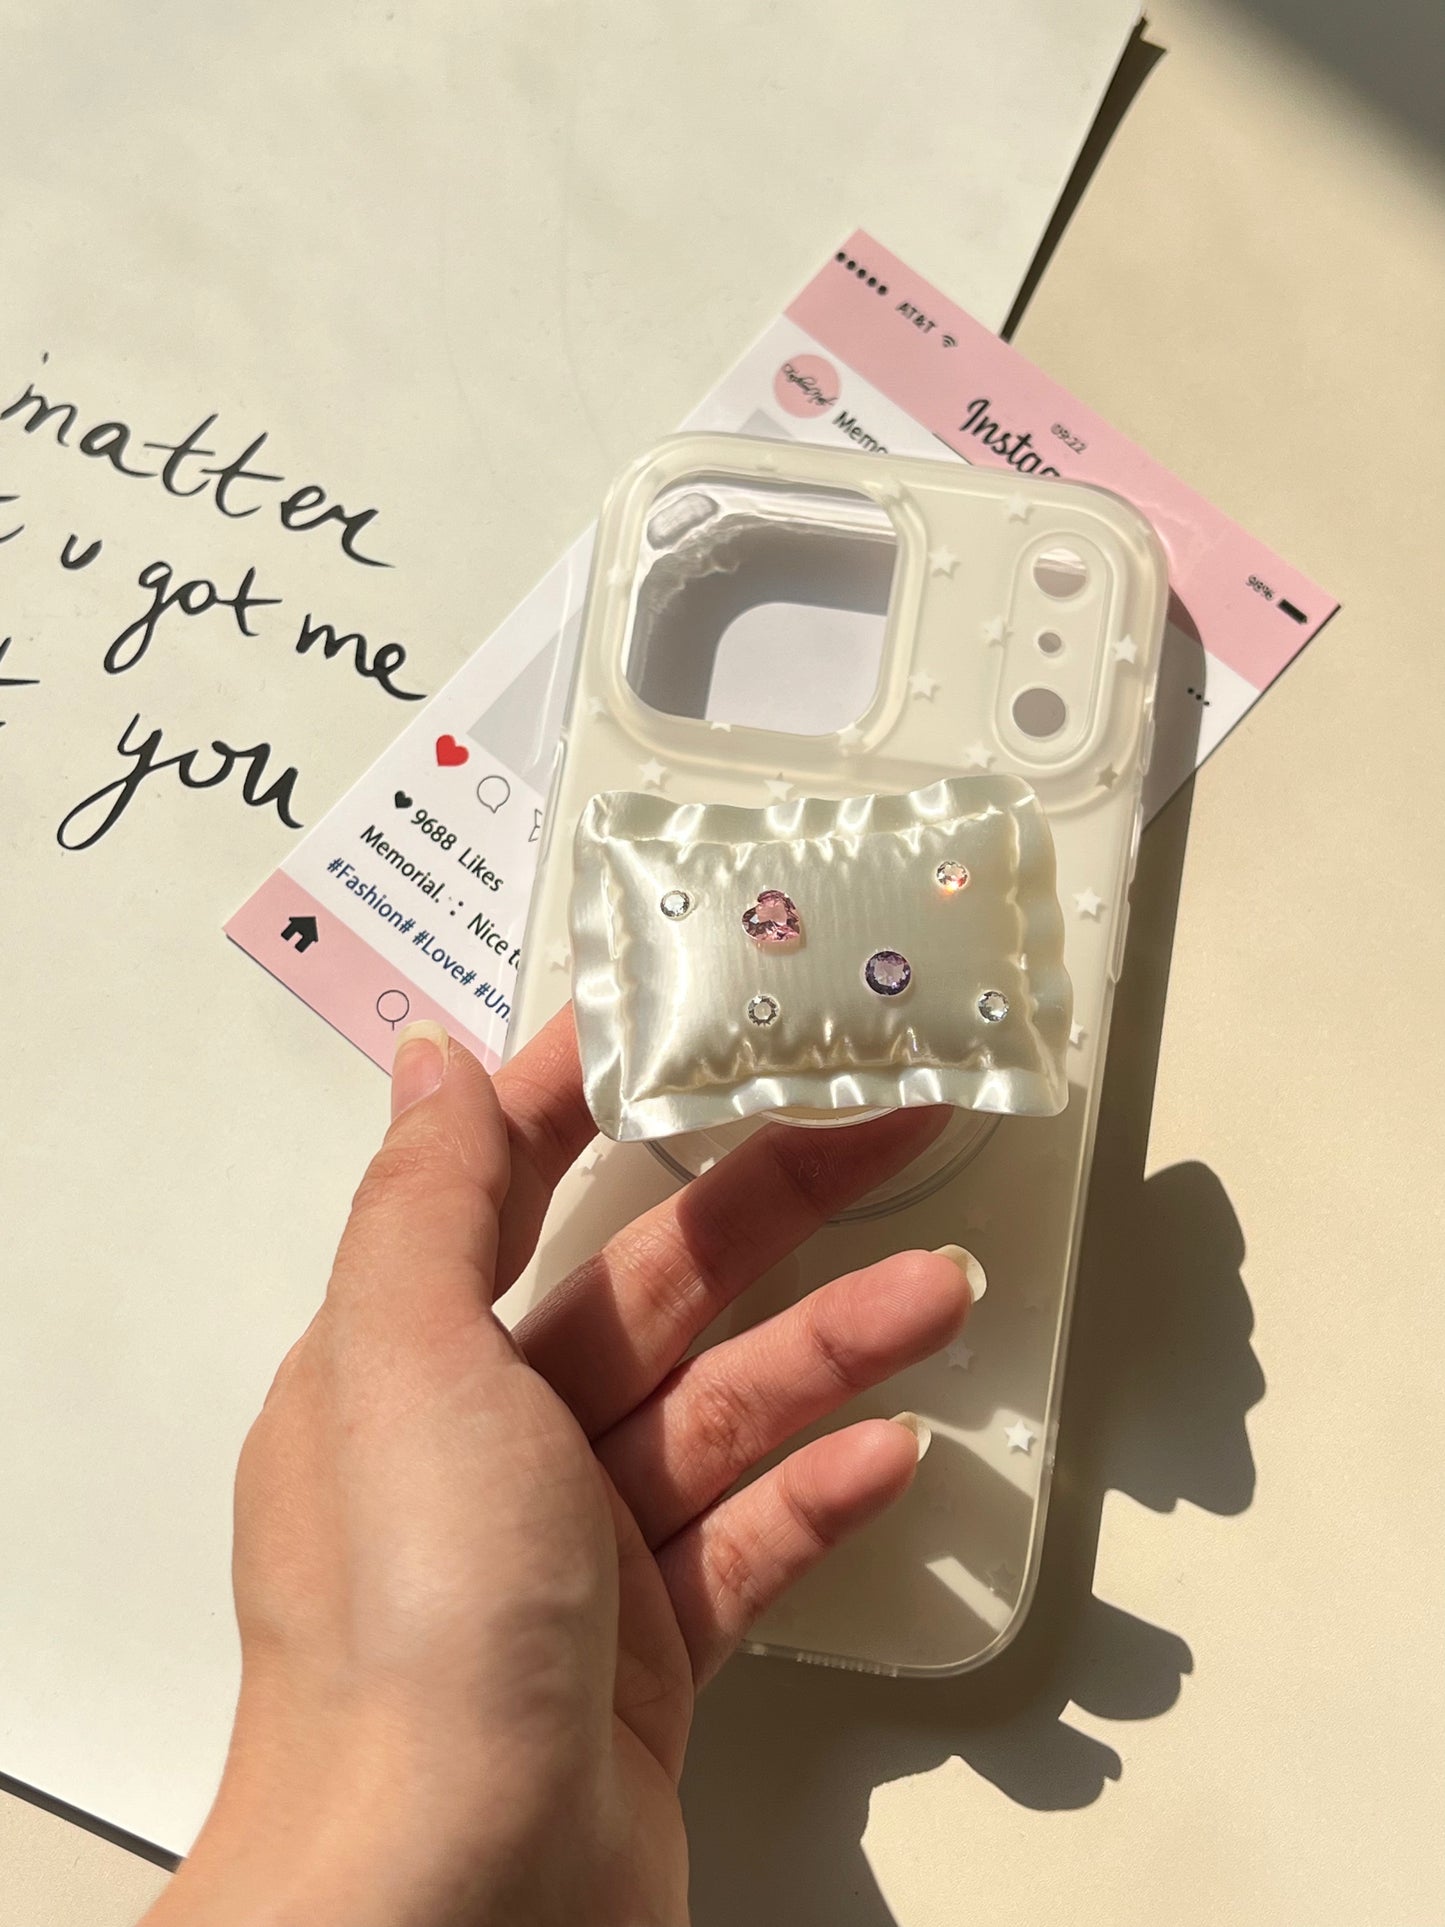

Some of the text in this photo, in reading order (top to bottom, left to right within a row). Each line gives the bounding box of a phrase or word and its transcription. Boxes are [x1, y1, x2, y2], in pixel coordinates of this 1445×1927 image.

[896, 301, 938, 334] AT&T
[0, 384, 397, 568] matter
[60, 533, 102, 570] u
[103, 561, 283, 674] got
[295, 613, 428, 701] me
[56, 713, 304, 851] you
[410, 808, 504, 893] 9688 Likes
[326, 857, 511, 1022] #Fashion# #Love# #Un
[466, 912, 509, 956] Nice
[508, 947, 521, 970] t
